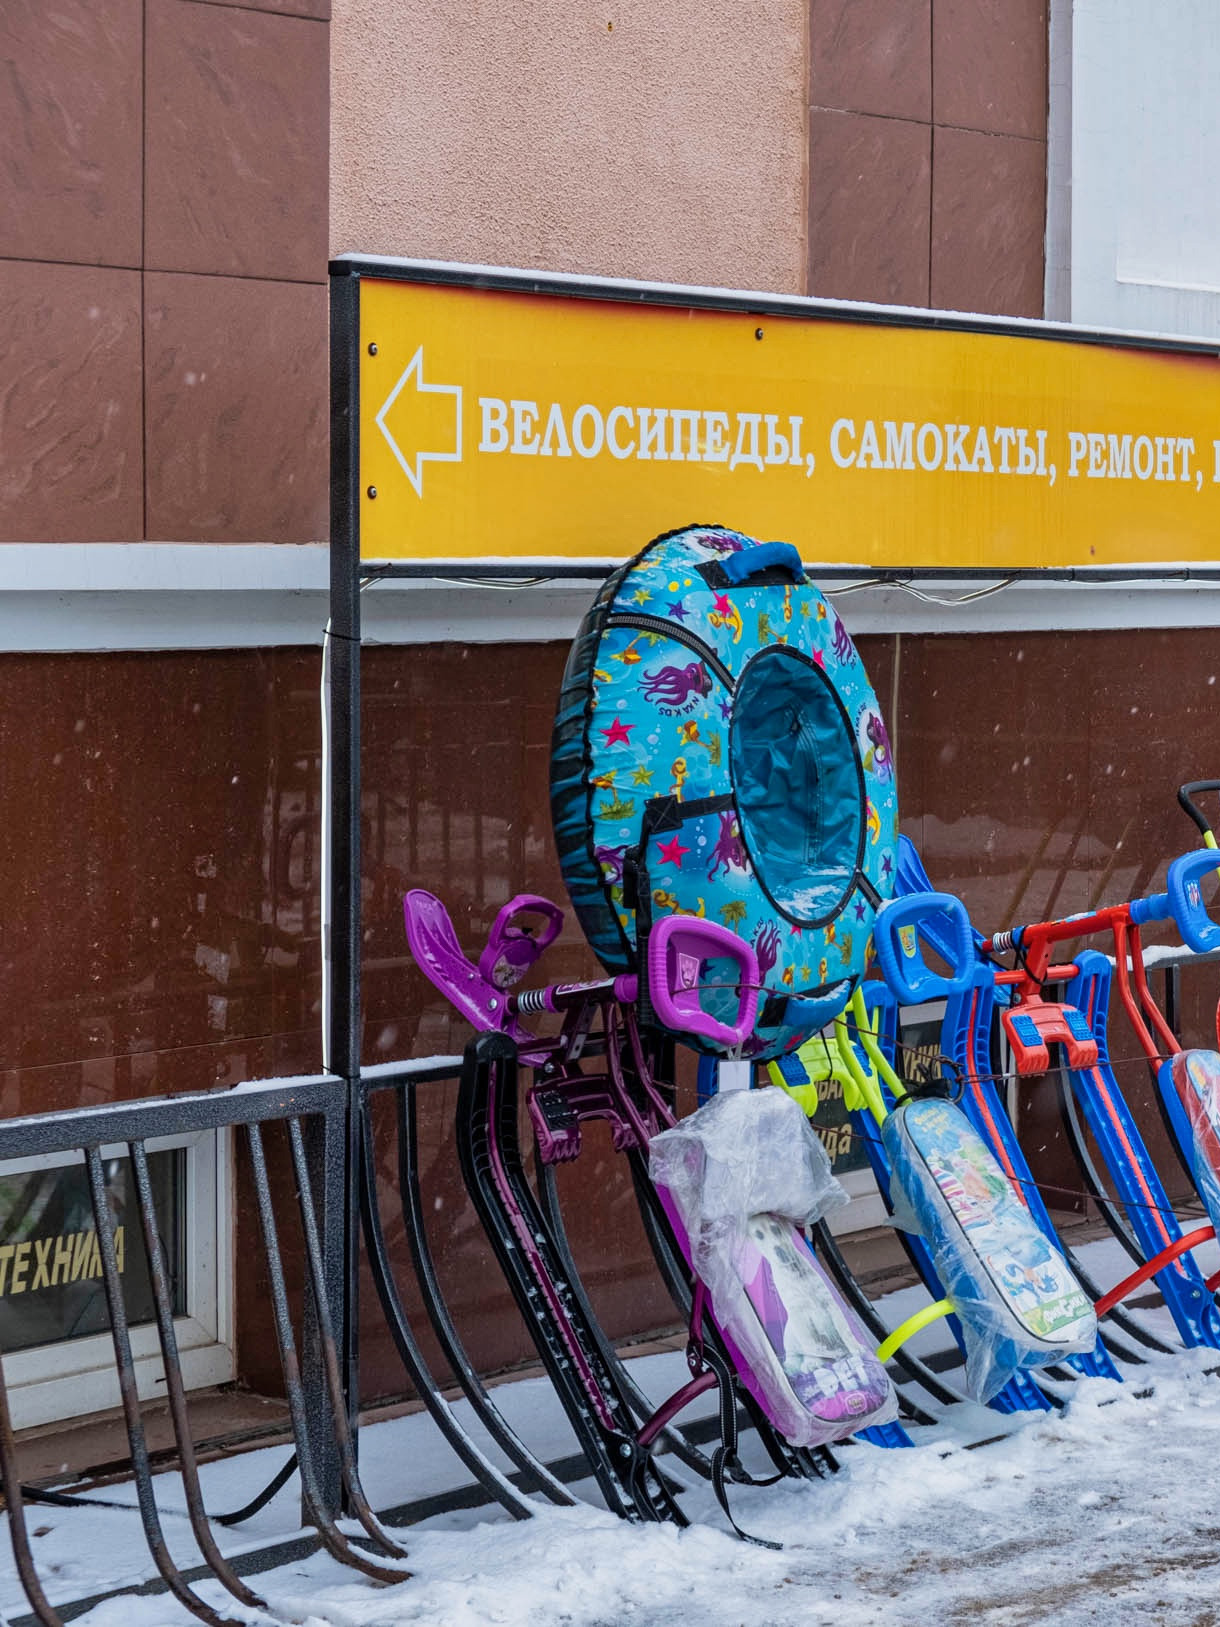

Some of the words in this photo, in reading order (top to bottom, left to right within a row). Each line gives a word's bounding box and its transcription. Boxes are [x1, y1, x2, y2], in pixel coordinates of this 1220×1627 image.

[478, 397, 816, 478] ВЕЛОСИПЕДЫ,
[830, 417, 1057, 487] САМОКАТЫ,
[1068, 431, 1204, 492] РЕМОНТ,
